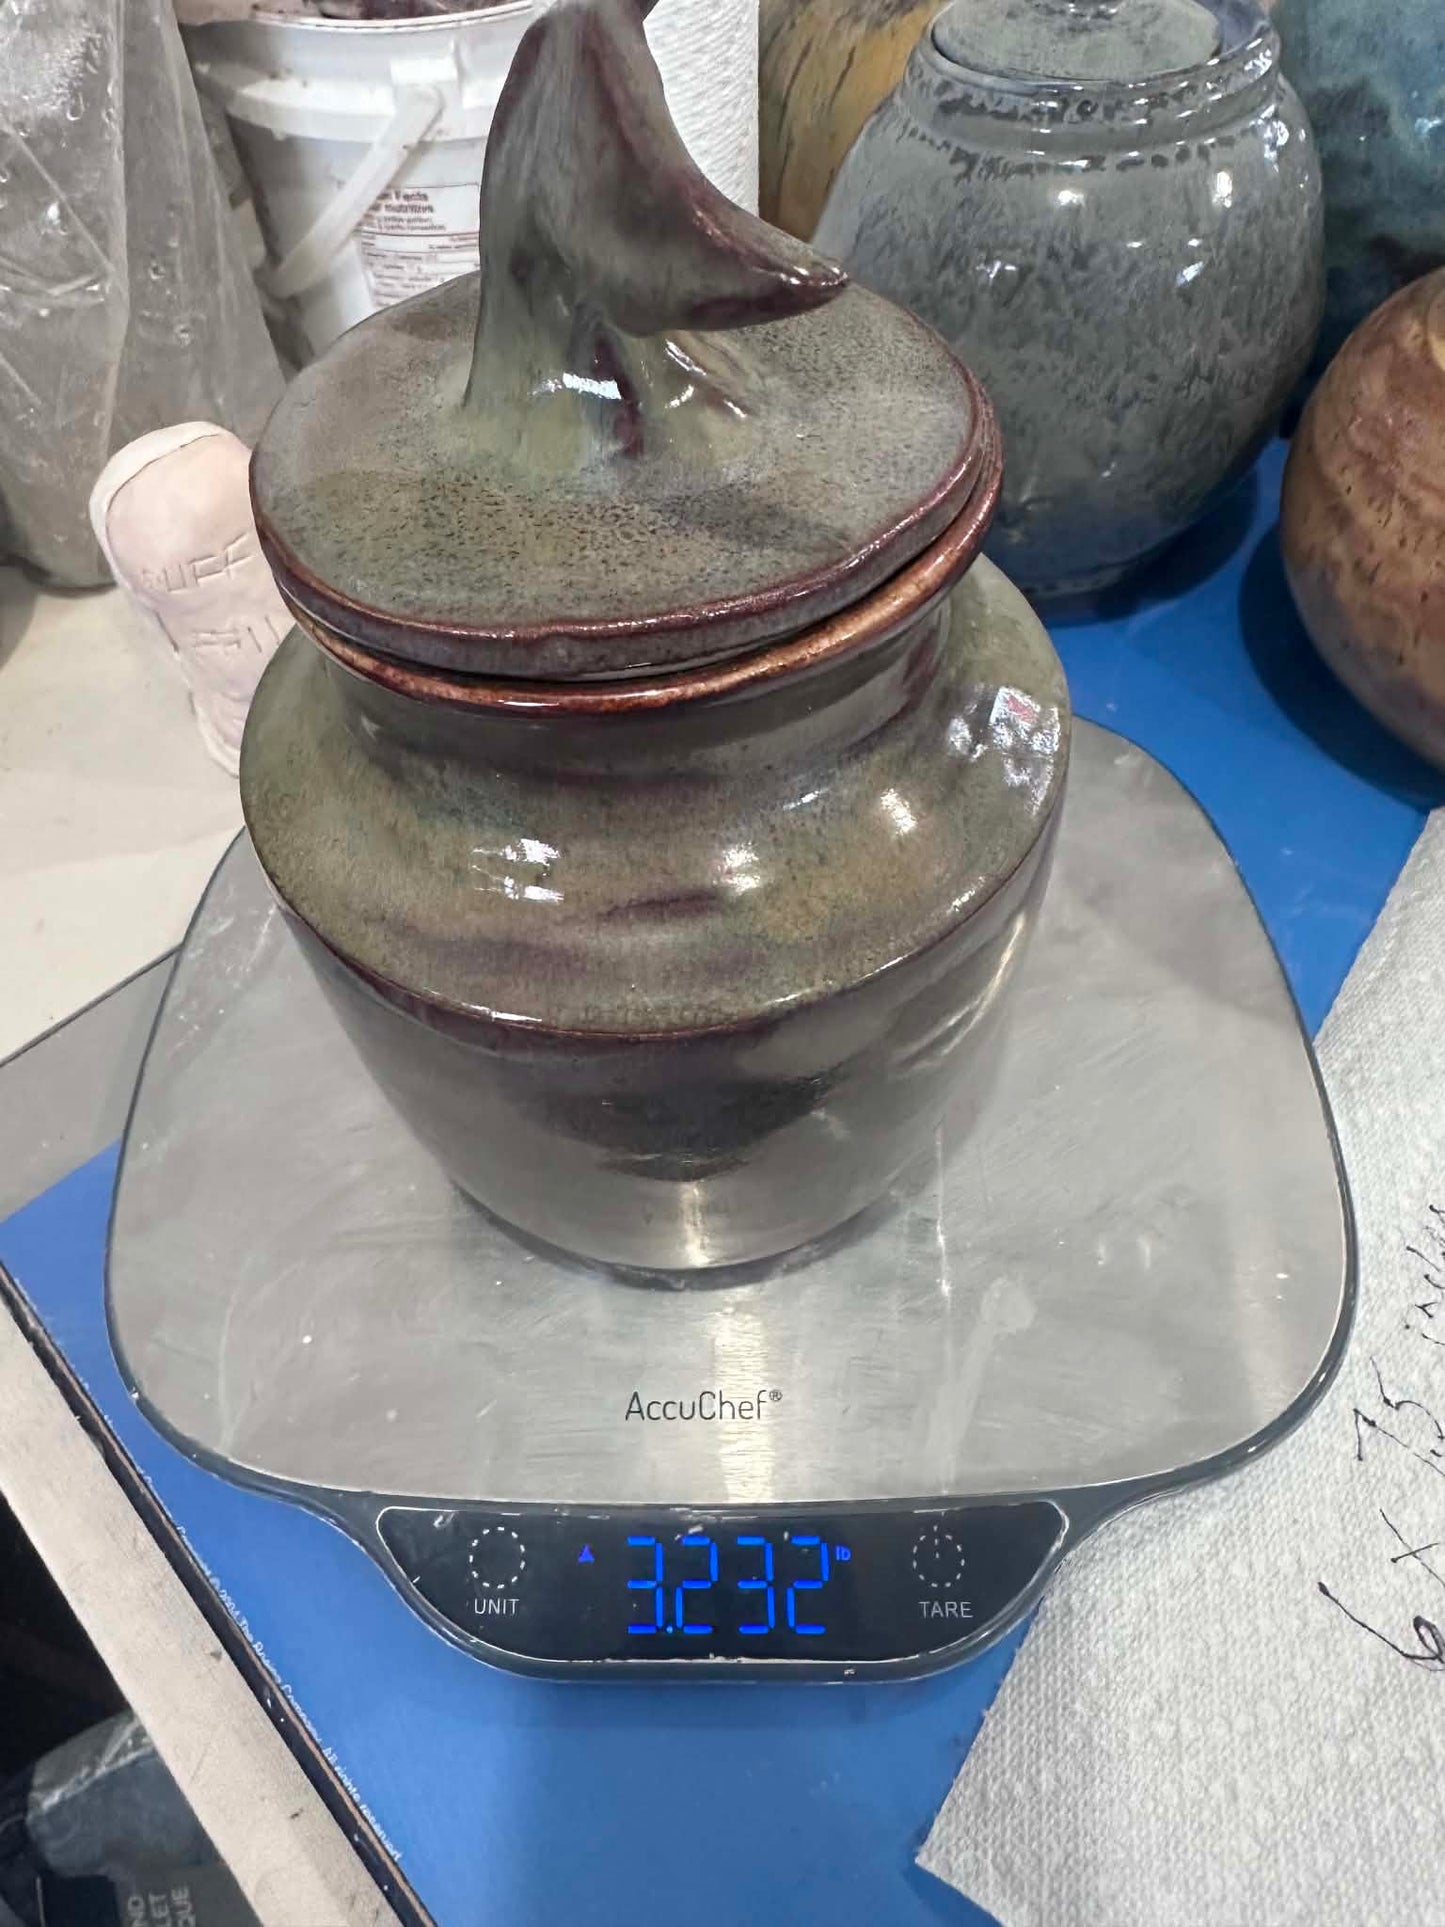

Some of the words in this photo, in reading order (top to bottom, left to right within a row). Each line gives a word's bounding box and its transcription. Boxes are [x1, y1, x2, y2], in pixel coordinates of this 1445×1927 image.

[626, 1535, 829, 1634] 3.232
[836, 1546, 851, 1561] lb
[474, 1598, 520, 1615] UNIT
[919, 1601, 974, 1618] TARE
